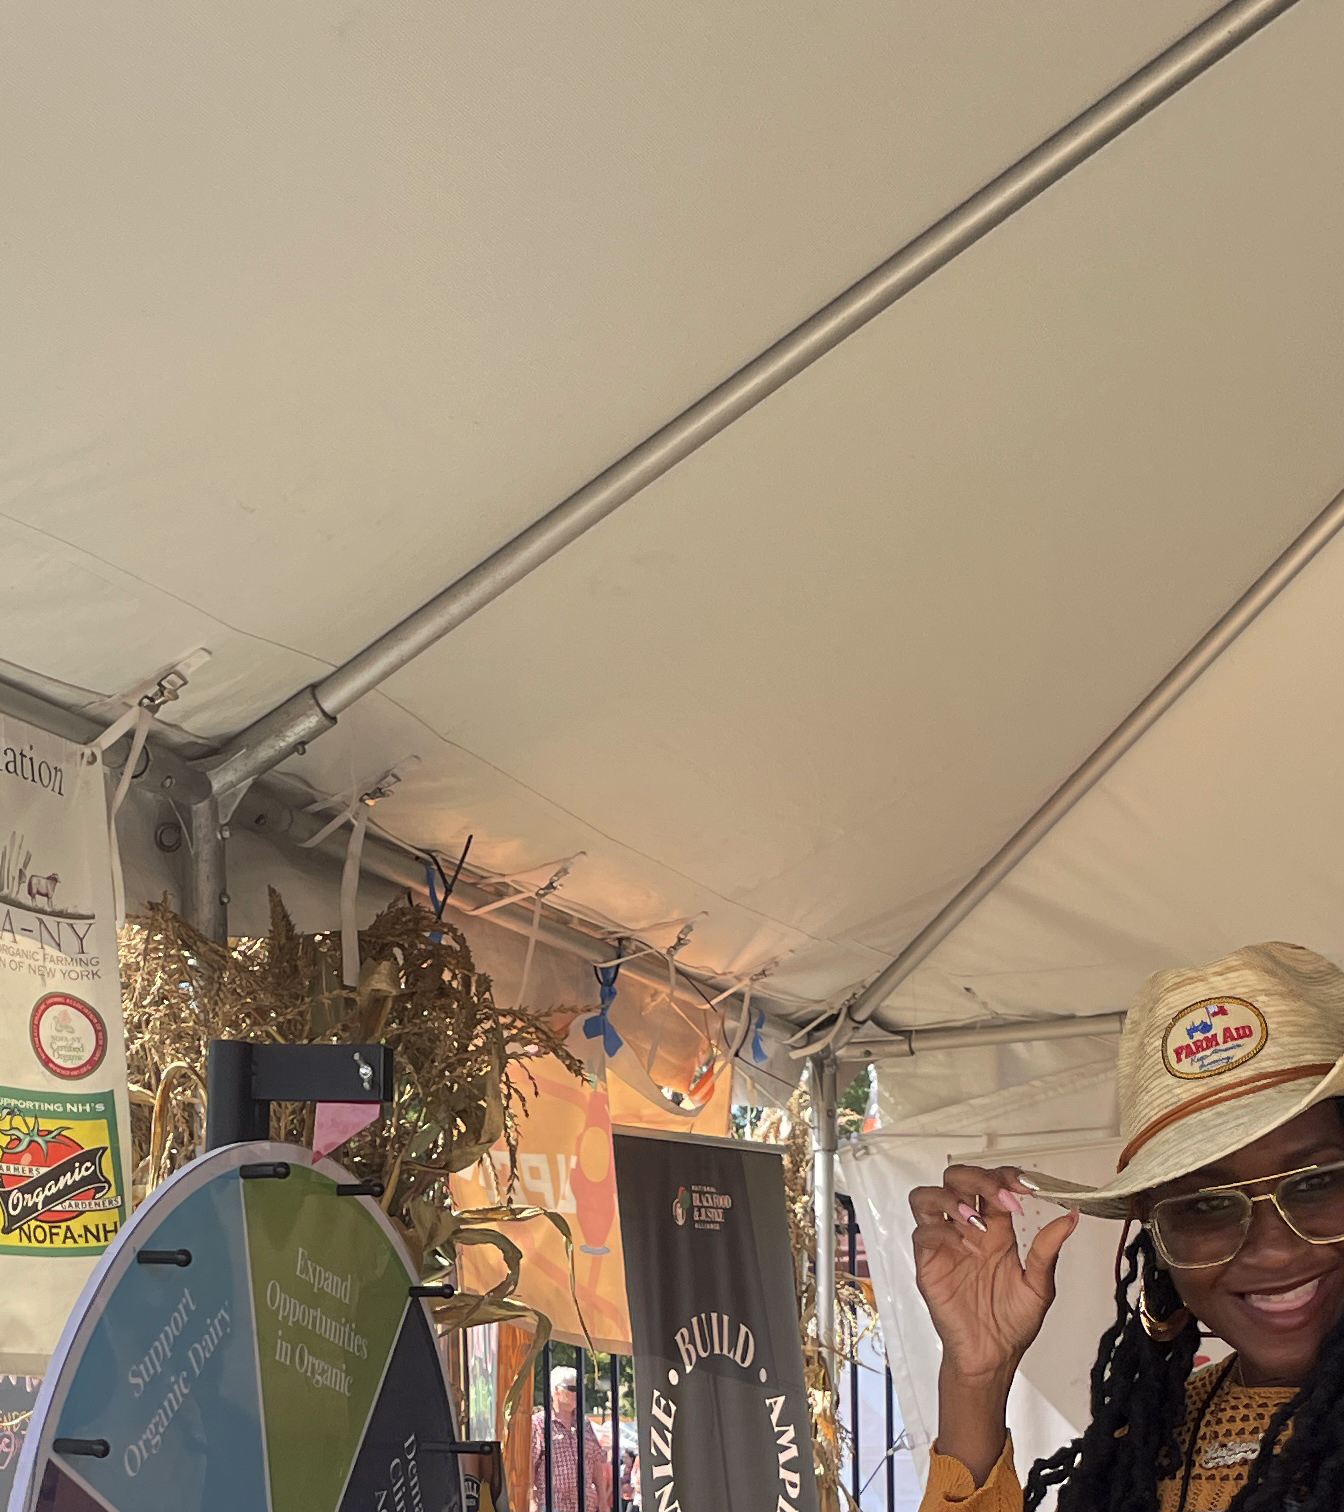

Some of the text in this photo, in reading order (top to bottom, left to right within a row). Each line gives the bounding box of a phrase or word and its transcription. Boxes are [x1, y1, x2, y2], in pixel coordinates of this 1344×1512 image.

[9, 959, 25, 972] OF
[28, 963, 57, 979] NEW
[59, 968, 102, 981] YORK
[43, 952, 100, 967] FARMING
[1173, 1032, 1221, 1065] FARM
[8, 1160, 96, 1216] Organic
[60, 1196, 121, 1210] GARDENERS
[18, 1221, 120, 1245] NOFA-NH
[296, 1247, 352, 1305] Expand
[128, 1287, 197, 1399] Support
[266, 1279, 368, 1360] Opportunities
[674, 1311, 755, 1374] BUILD
[124, 1299, 232, 1477] Organic Dairy
[275, 1330, 353, 1398] in Organic
